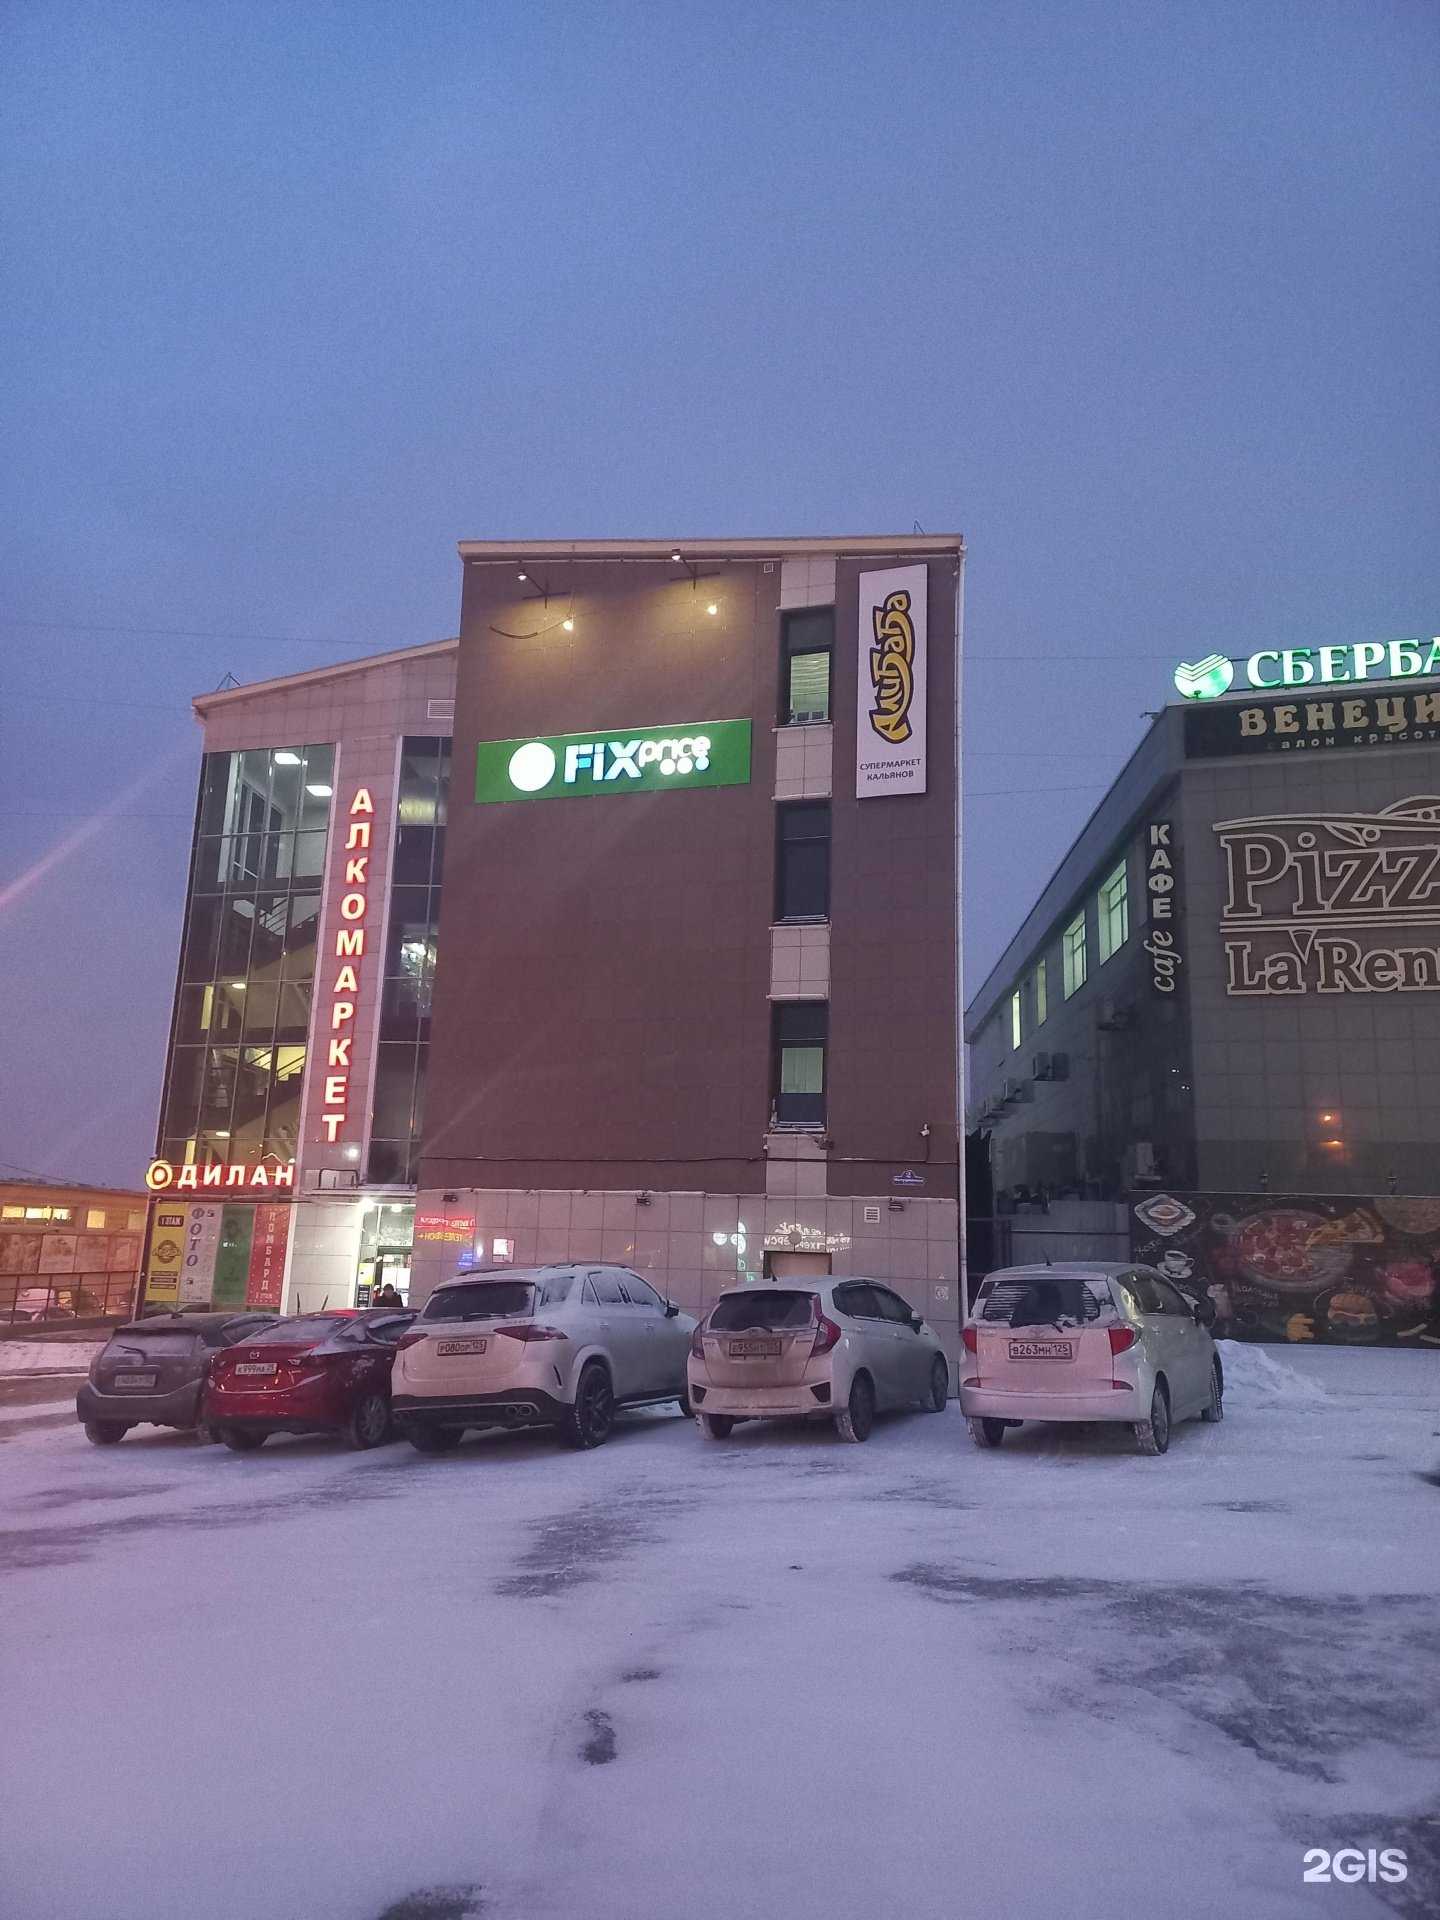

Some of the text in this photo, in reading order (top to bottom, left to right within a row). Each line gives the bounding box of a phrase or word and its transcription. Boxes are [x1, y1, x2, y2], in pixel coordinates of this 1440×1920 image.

[859, 758, 922, 771] СУПЕРМАРКЕТ
[866, 769, 915, 782] КАЛЬЯНОВ
[1149, 824, 1175, 919] КАФЕ
[322, 788, 375, 1143] АЛКОМАРКЕТ
[1143, 929, 1183, 993] cafe
[186, 1207, 206, 1267] ФОТО
[261, 1211, 277, 1290] ЛОМБАРД
